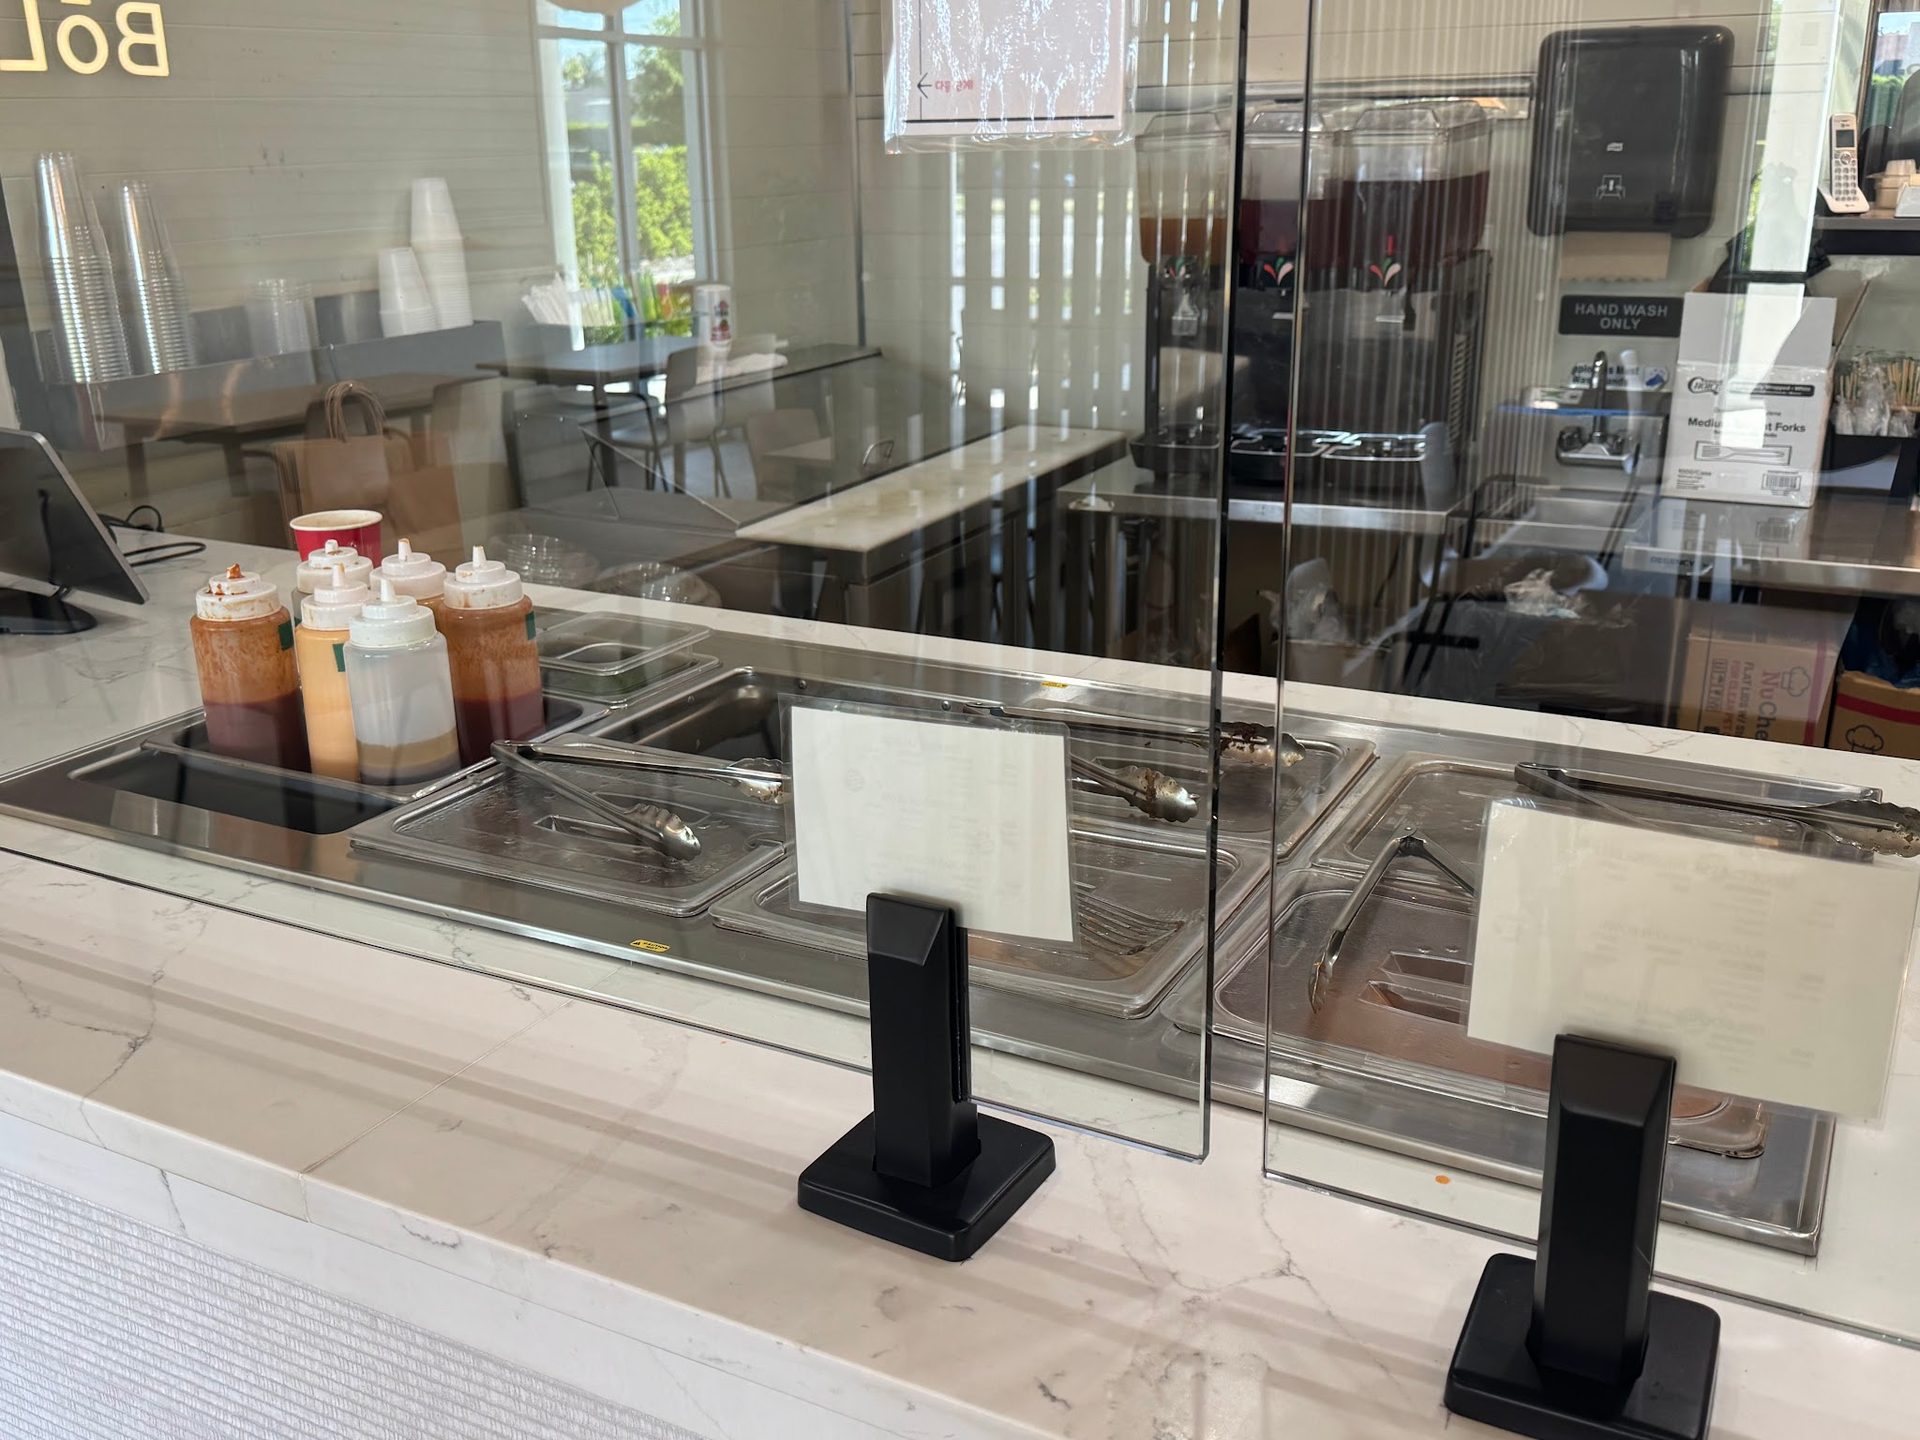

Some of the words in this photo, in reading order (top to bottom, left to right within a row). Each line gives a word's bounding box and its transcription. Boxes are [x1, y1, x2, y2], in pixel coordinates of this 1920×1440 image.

[1575, 303, 1619, 316] HAND
[1623, 304, 1668, 317] WASH
[1600, 317, 1641, 330] ONLY
[1688, 417, 1722, 428] Mediu
[1775, 422, 1806, 433] Forks
